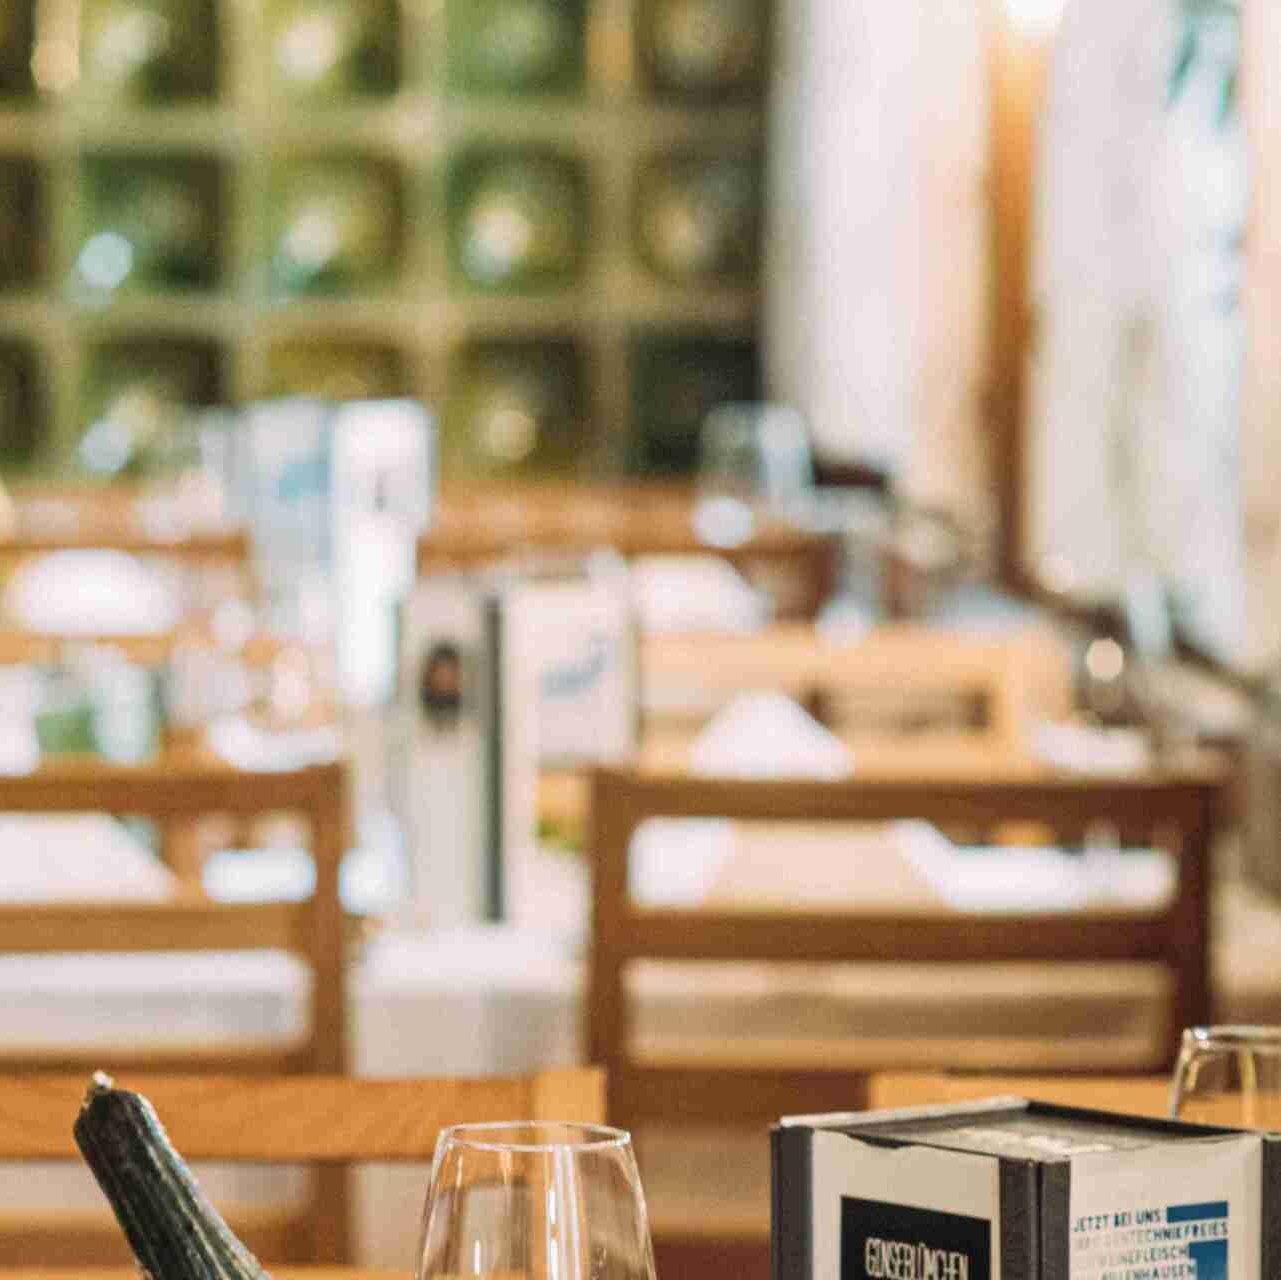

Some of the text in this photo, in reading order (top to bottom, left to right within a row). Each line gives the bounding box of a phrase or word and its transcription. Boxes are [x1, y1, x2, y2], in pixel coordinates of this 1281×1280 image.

[1073, 1208, 1162, 1233] JETZT BEI UNS
